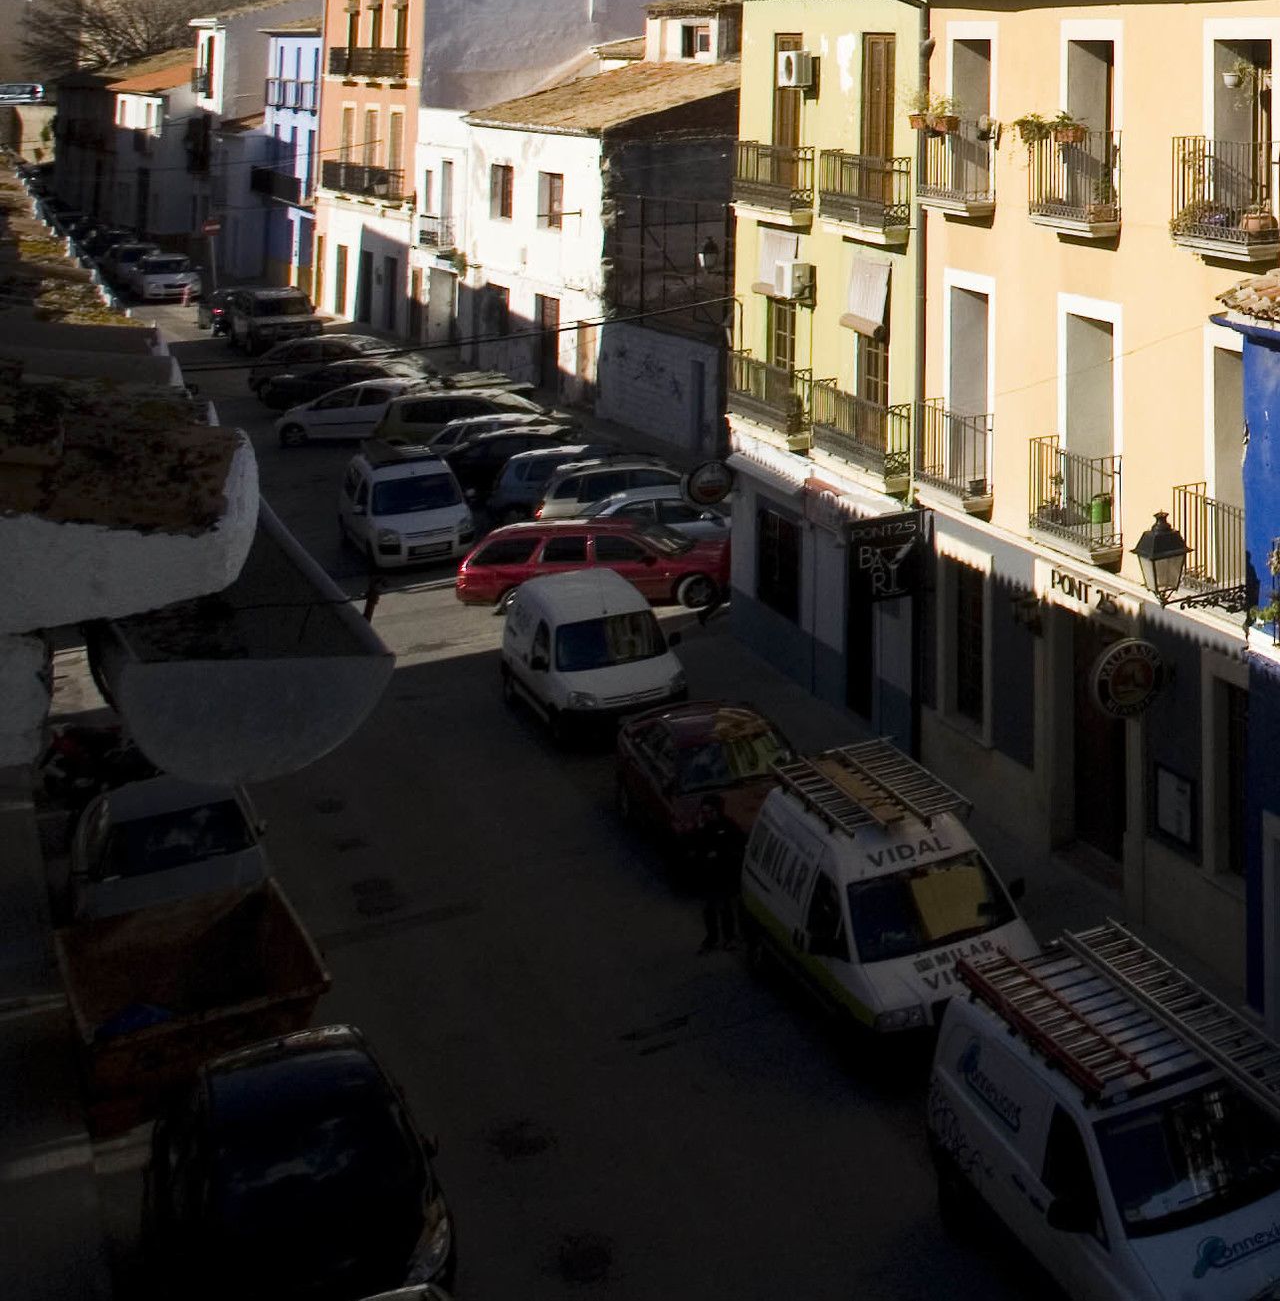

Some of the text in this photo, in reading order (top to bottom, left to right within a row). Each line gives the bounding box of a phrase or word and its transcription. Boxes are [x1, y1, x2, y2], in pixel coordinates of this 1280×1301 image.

[1051, 568, 1119, 615] PONT 25
[867, 836, 951, 868] VIDAL
[933, 938, 995, 966] MILAR
